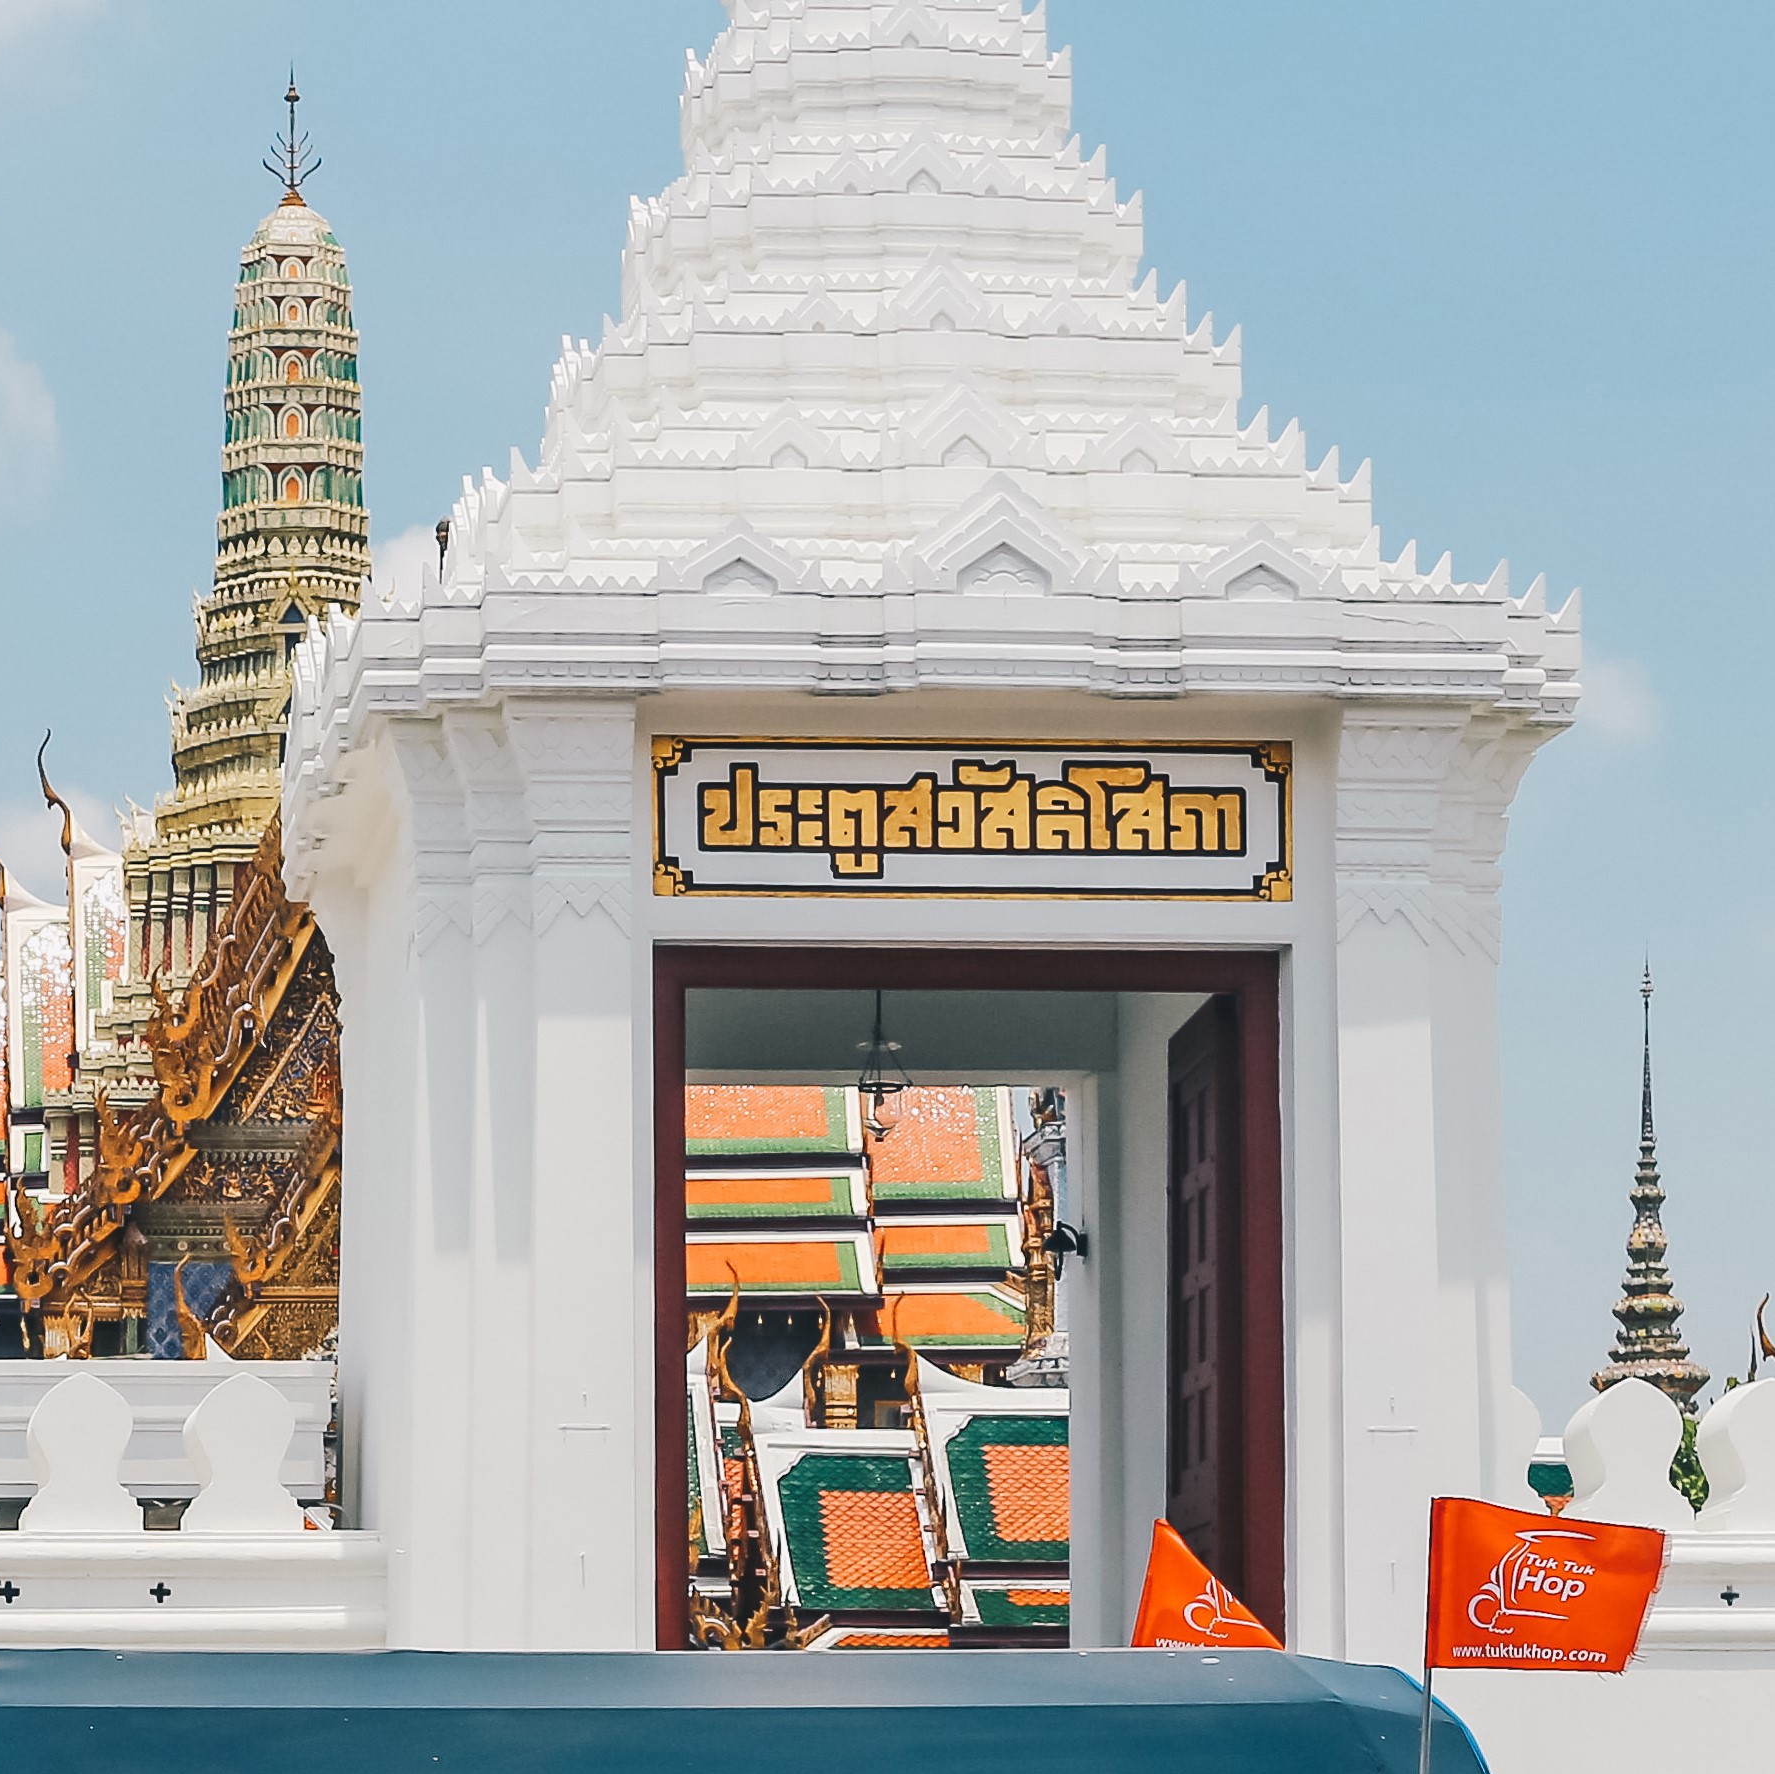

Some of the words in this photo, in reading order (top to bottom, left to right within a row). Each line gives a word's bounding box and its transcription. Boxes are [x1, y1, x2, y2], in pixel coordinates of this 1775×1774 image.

[699, 761, 1245, 877] ประตูสวัสดิโสภา
[1526, 1553, 1559, 1570] Tuk
[1563, 1560, 1596, 1576] Tuk
[1518, 1567, 1586, 1602] Hop
[1452, 1642, 1607, 1663] www.tuktukhop.com
